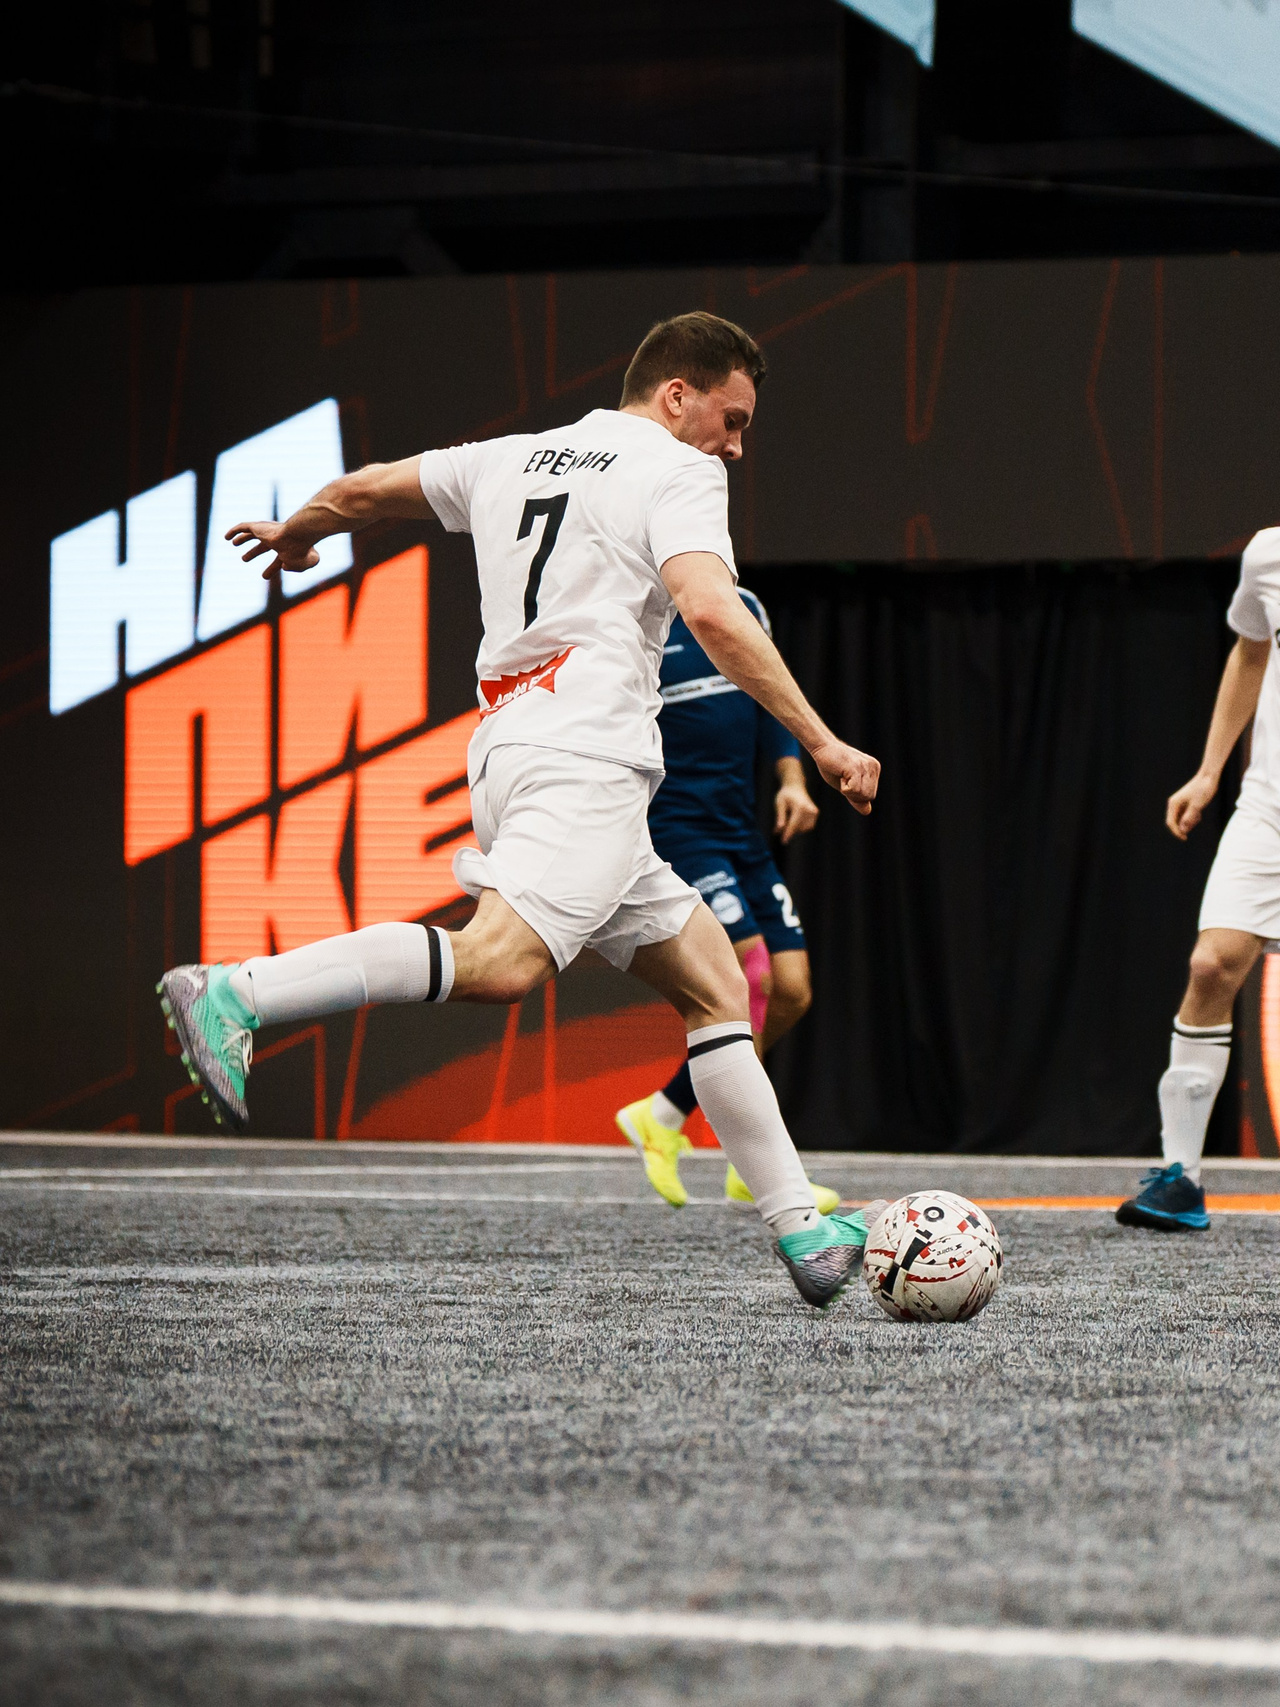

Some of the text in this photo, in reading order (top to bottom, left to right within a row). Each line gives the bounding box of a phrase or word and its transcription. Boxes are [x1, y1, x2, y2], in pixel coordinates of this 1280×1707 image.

[50, 397, 354, 717] НА
[516, 492, 569, 630] 7
[125, 545, 429, 867] ПИ
[201, 707, 480, 965] КЕ
